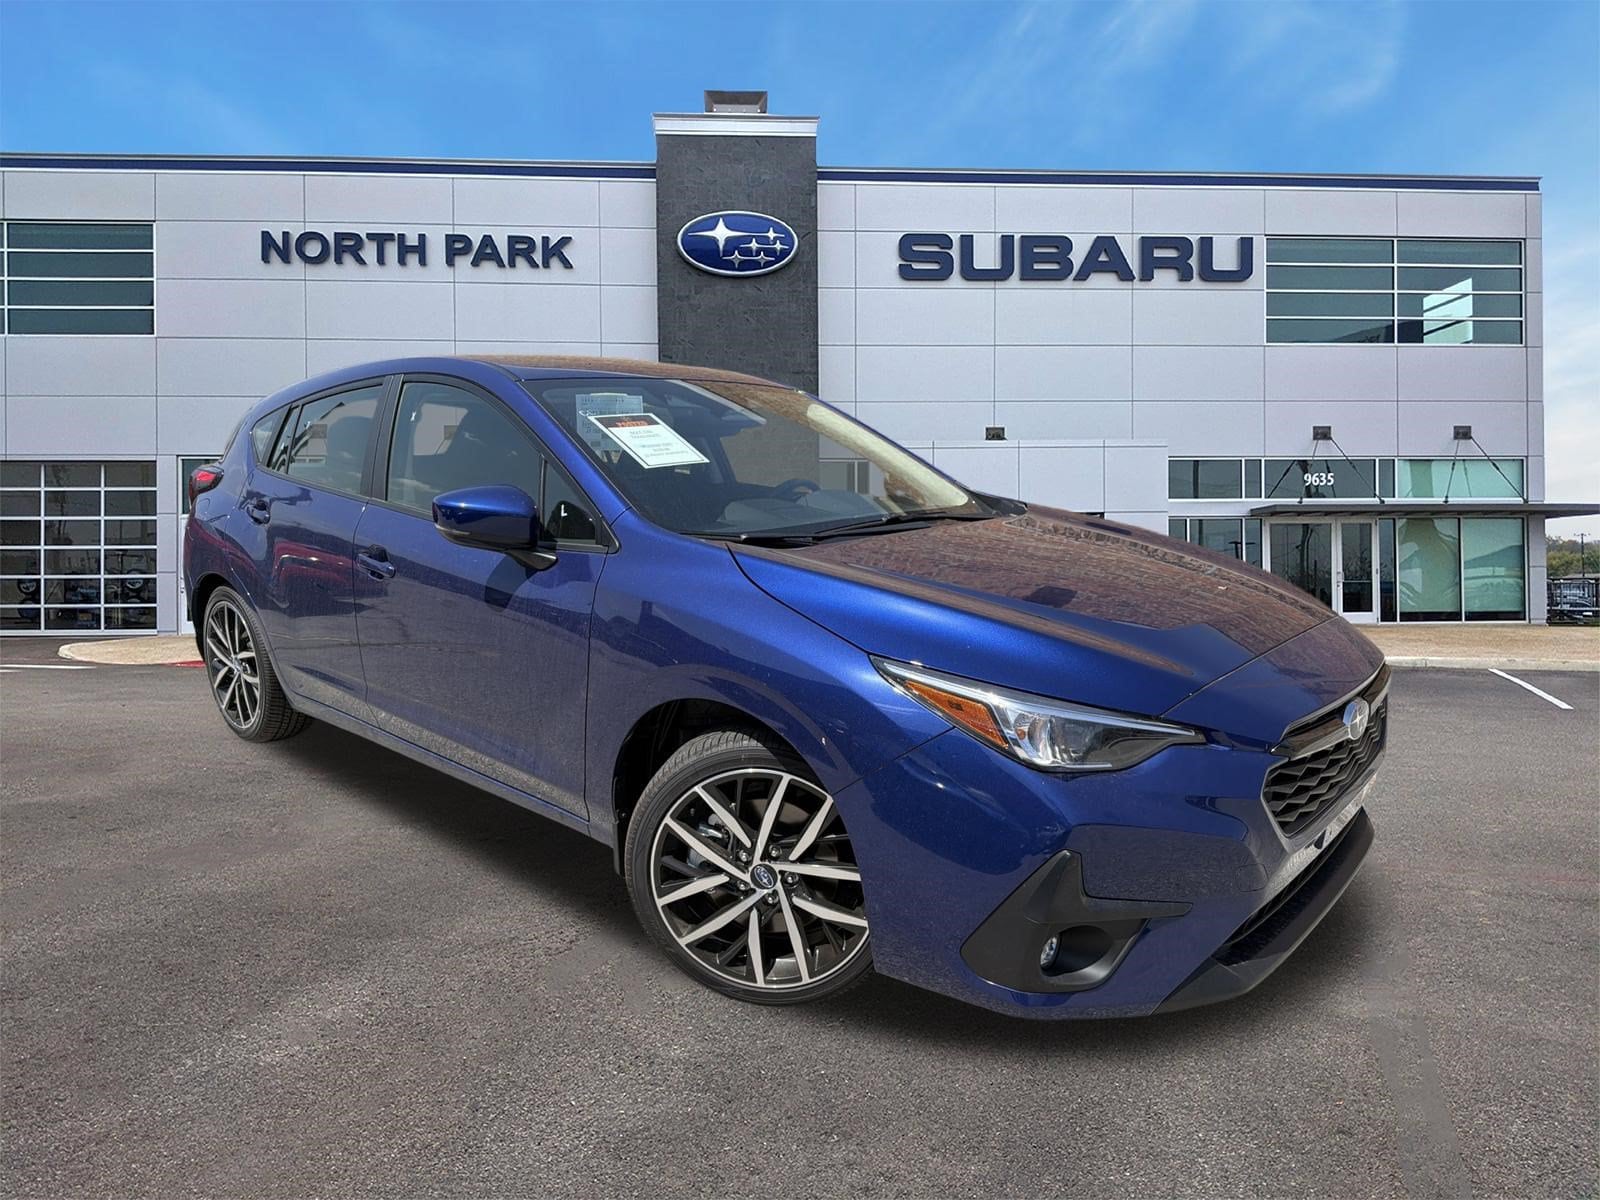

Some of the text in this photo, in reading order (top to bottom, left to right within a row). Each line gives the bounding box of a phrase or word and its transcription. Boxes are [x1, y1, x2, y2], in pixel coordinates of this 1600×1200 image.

[261, 230, 574, 269] NORTH PARK
[898, 233, 1253, 283] SUBARU
[1303, 472, 1335, 486] 9635
